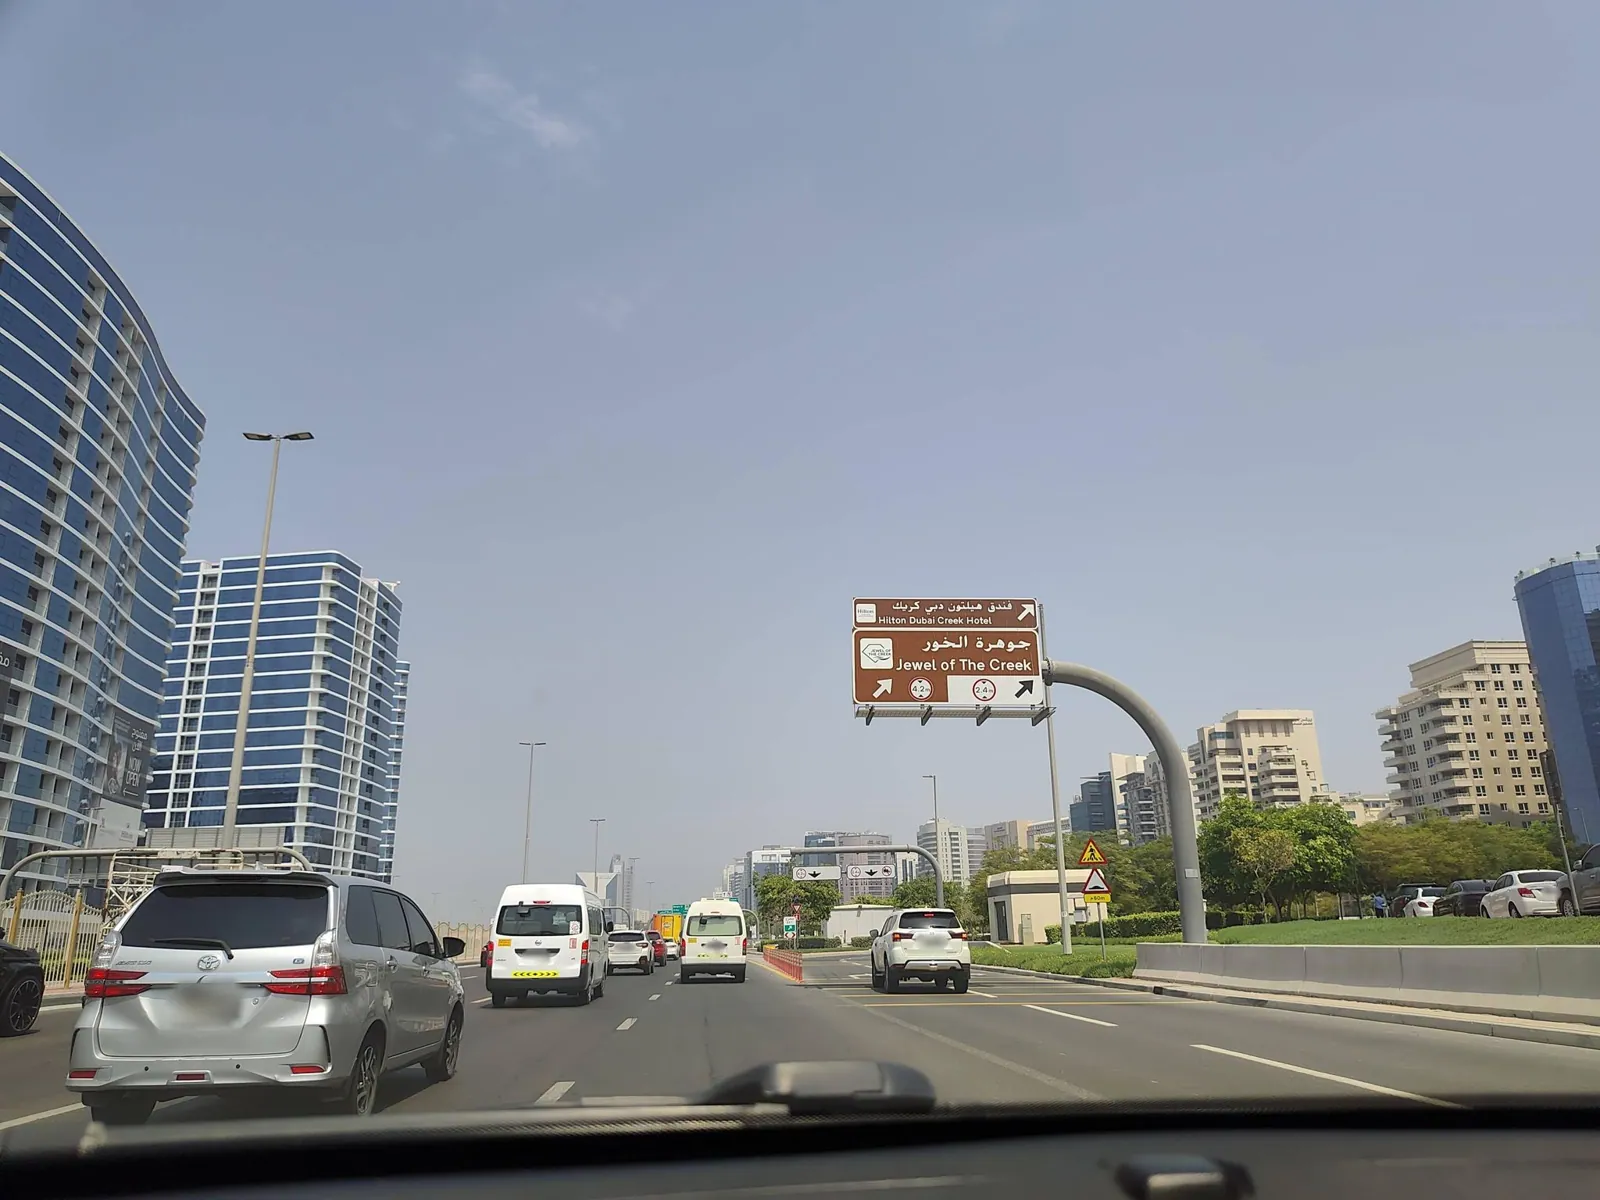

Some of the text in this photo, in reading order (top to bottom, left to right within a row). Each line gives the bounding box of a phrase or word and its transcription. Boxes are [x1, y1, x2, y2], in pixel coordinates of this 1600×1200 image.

[892, 600, 1013, 615] فندق هيلتون دبي كريك
[878, 616, 993, 625] Hilton Dubai Creek Hotel
[922, 635, 1032, 652] جوهرة الخور
[896, 658, 1032, 671] Jewel of The Creek
[129, 757, 142, 772] NOW
[125, 772, 141, 787] OPEN
